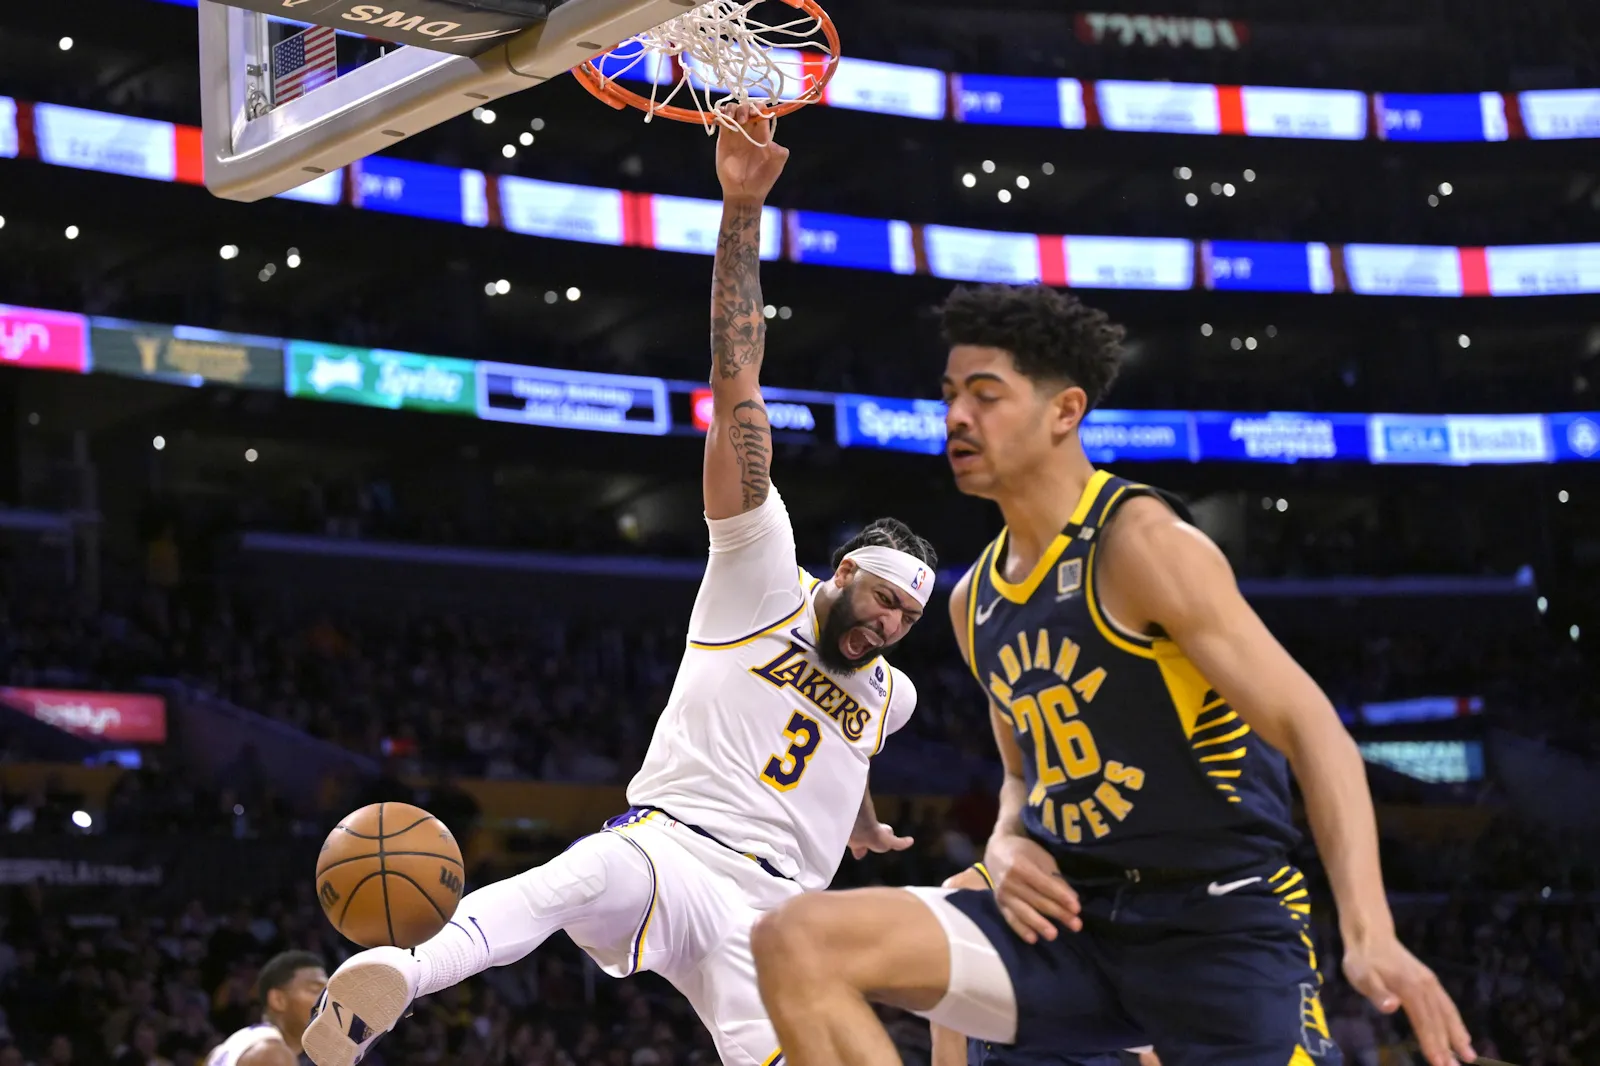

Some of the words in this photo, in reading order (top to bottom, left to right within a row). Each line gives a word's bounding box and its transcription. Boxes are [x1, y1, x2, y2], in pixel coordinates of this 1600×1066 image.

[749, 640, 872, 742] LAKERS
[868, 675, 888, 698] bibigo
[759, 709, 823, 793] 3
[1010, 683, 1101, 787] 26
